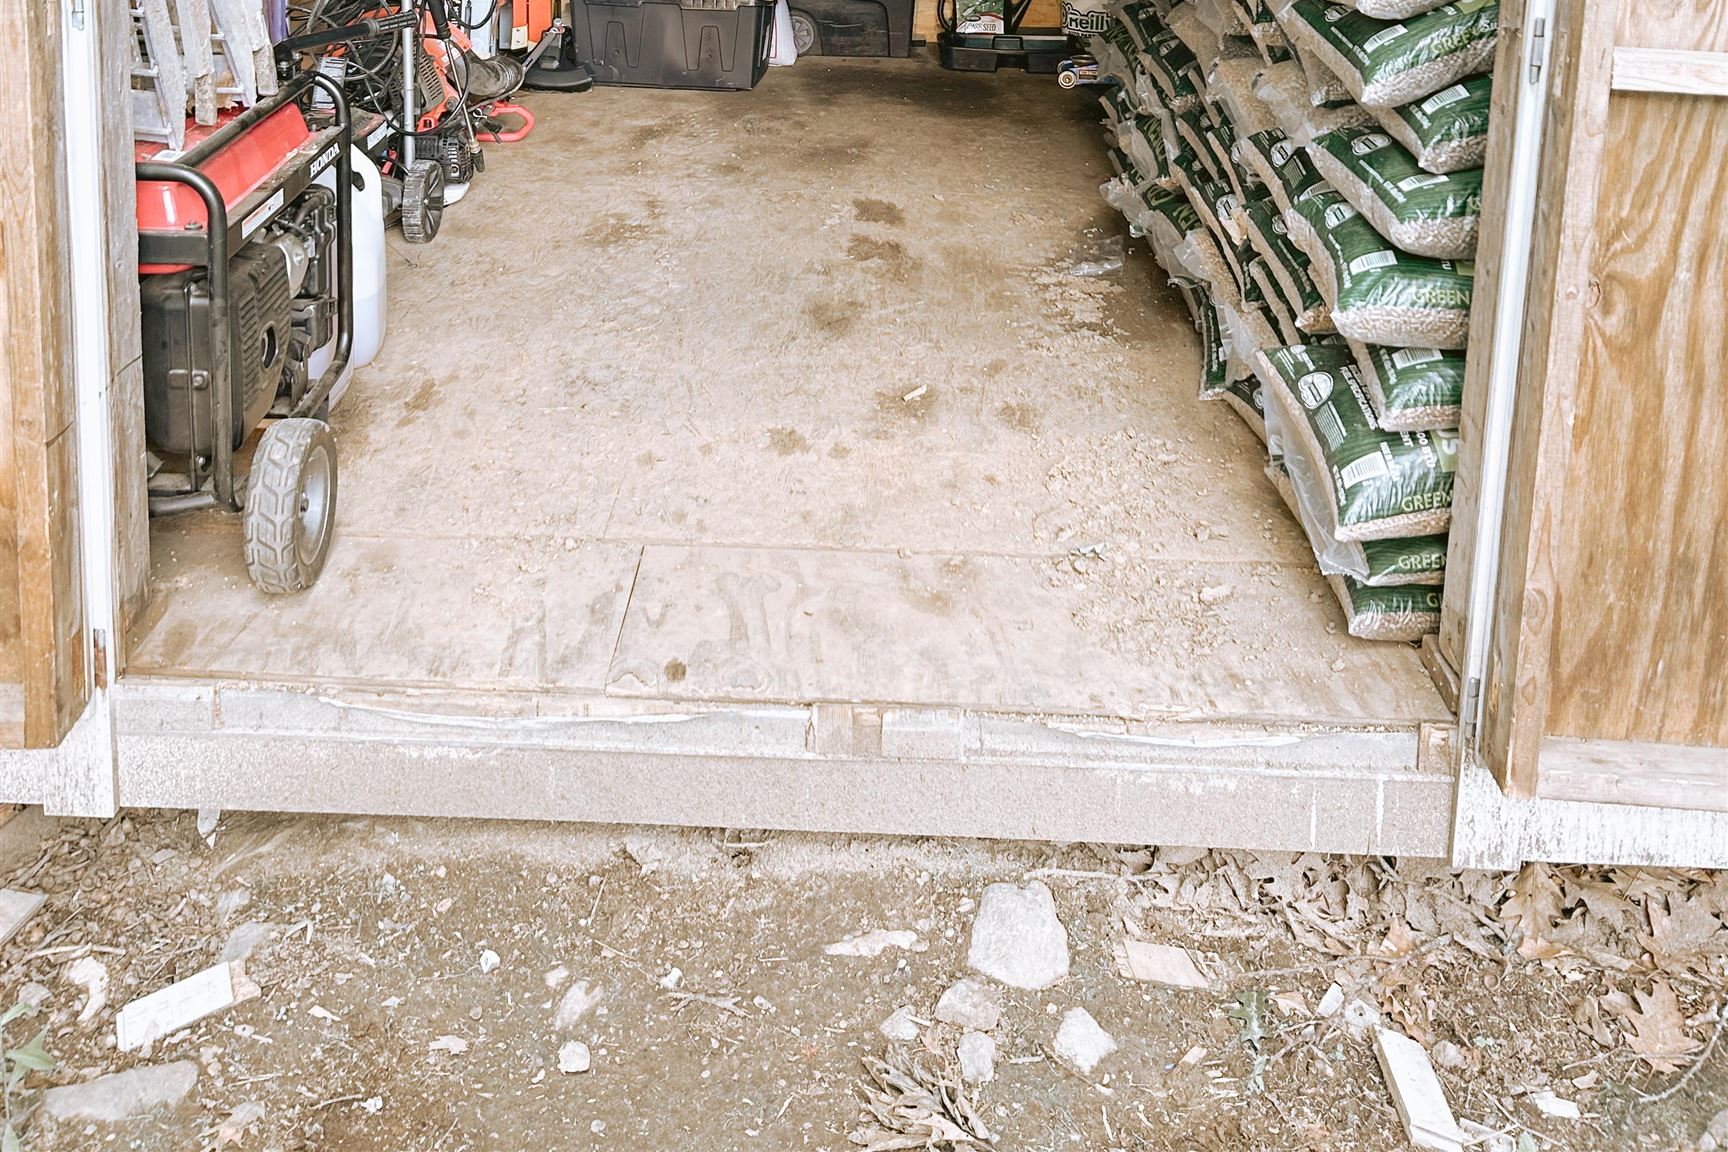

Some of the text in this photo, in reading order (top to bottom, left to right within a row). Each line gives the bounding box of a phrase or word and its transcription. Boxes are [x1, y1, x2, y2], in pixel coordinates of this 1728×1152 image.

[309, 142, 341, 179] HONDA
[1413, 289, 1470, 305] GREEN
[1402, 490, 1452, 511] GREEN
